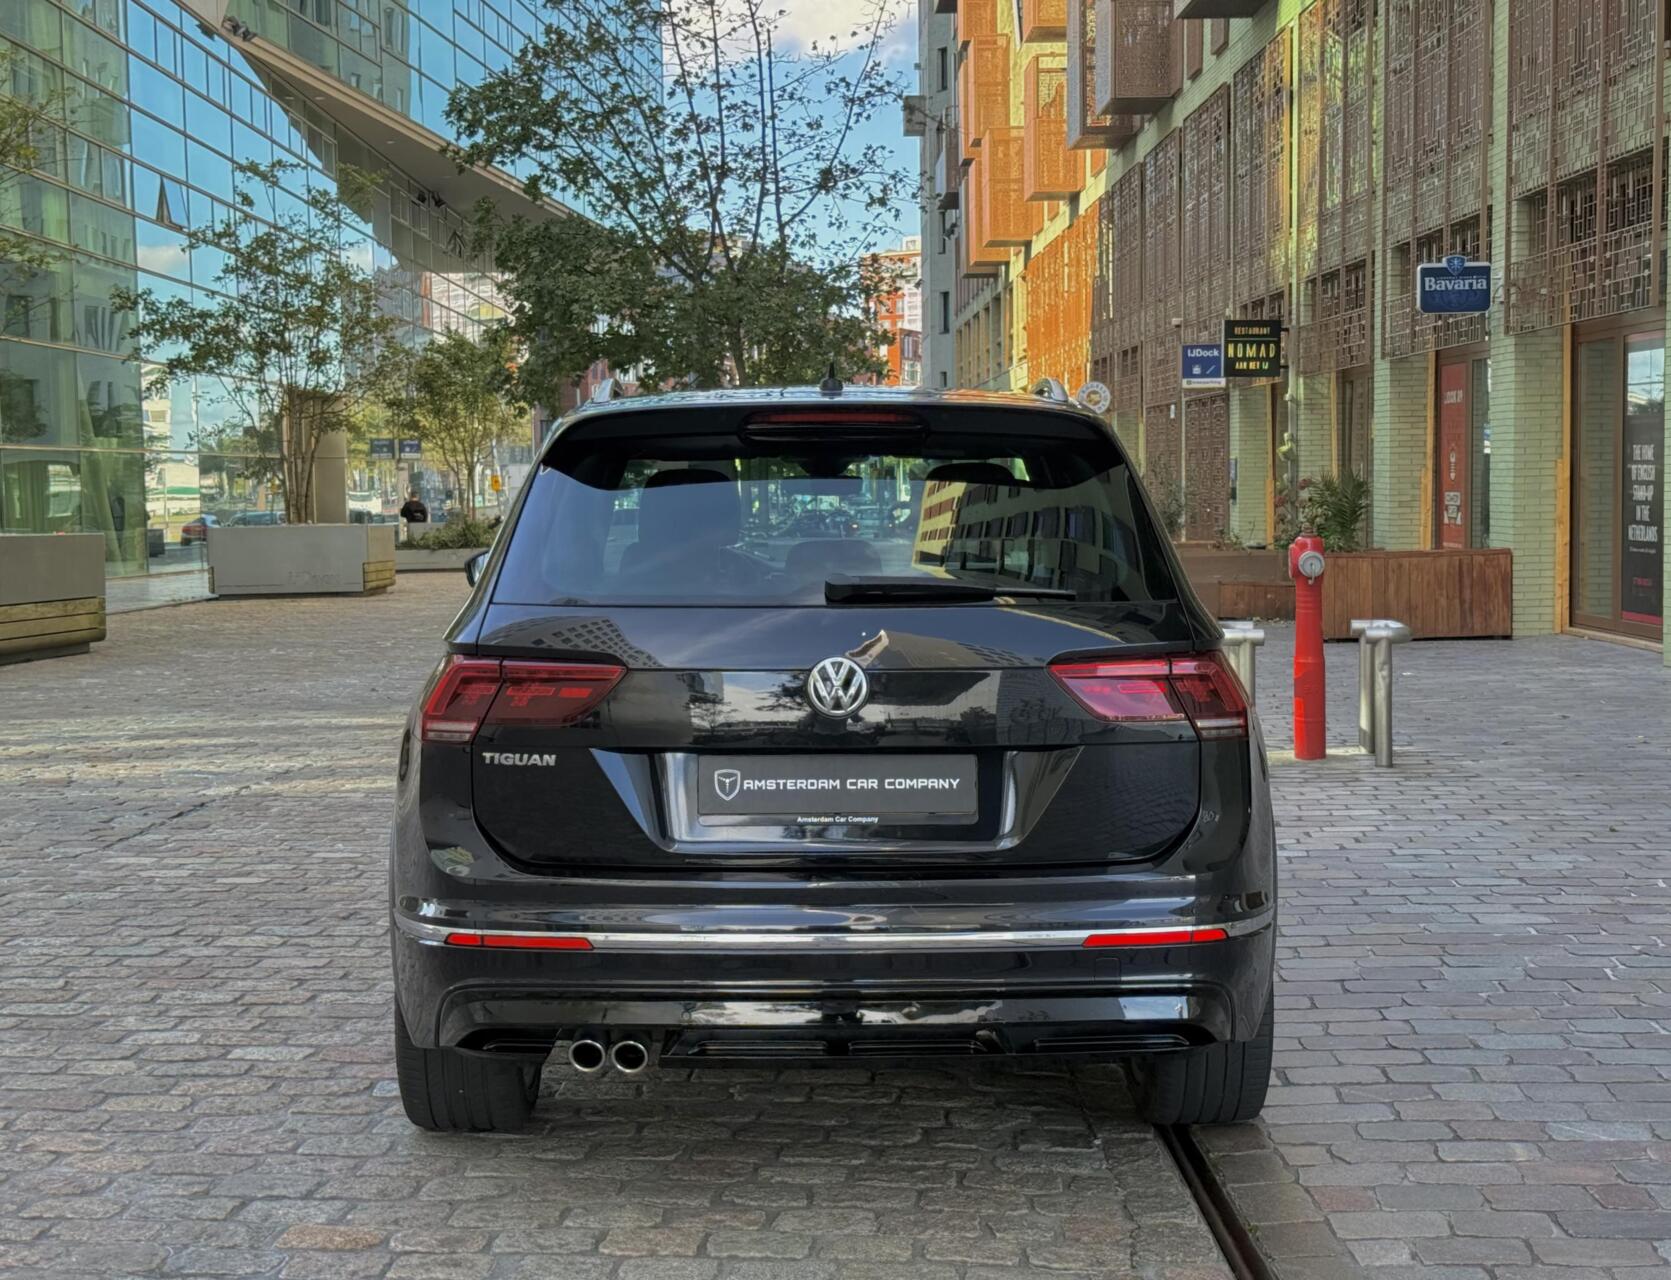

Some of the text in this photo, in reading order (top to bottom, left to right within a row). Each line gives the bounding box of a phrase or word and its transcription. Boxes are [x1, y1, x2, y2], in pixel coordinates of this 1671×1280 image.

[1424, 277, 1487, 291] Bavaria
[1234, 326, 1271, 335] RESTAURANT
[1187, 348, 1220, 357] IJDock
[1228, 343, 1276, 358] NOMAD
[1235, 362, 1269, 370] AAN HET IJ
[482, 752, 557, 766] TIGUAN
[743, 778, 960, 790] AMSTERDAM CAR COMPANY
[848, 816, 879, 824] Company
